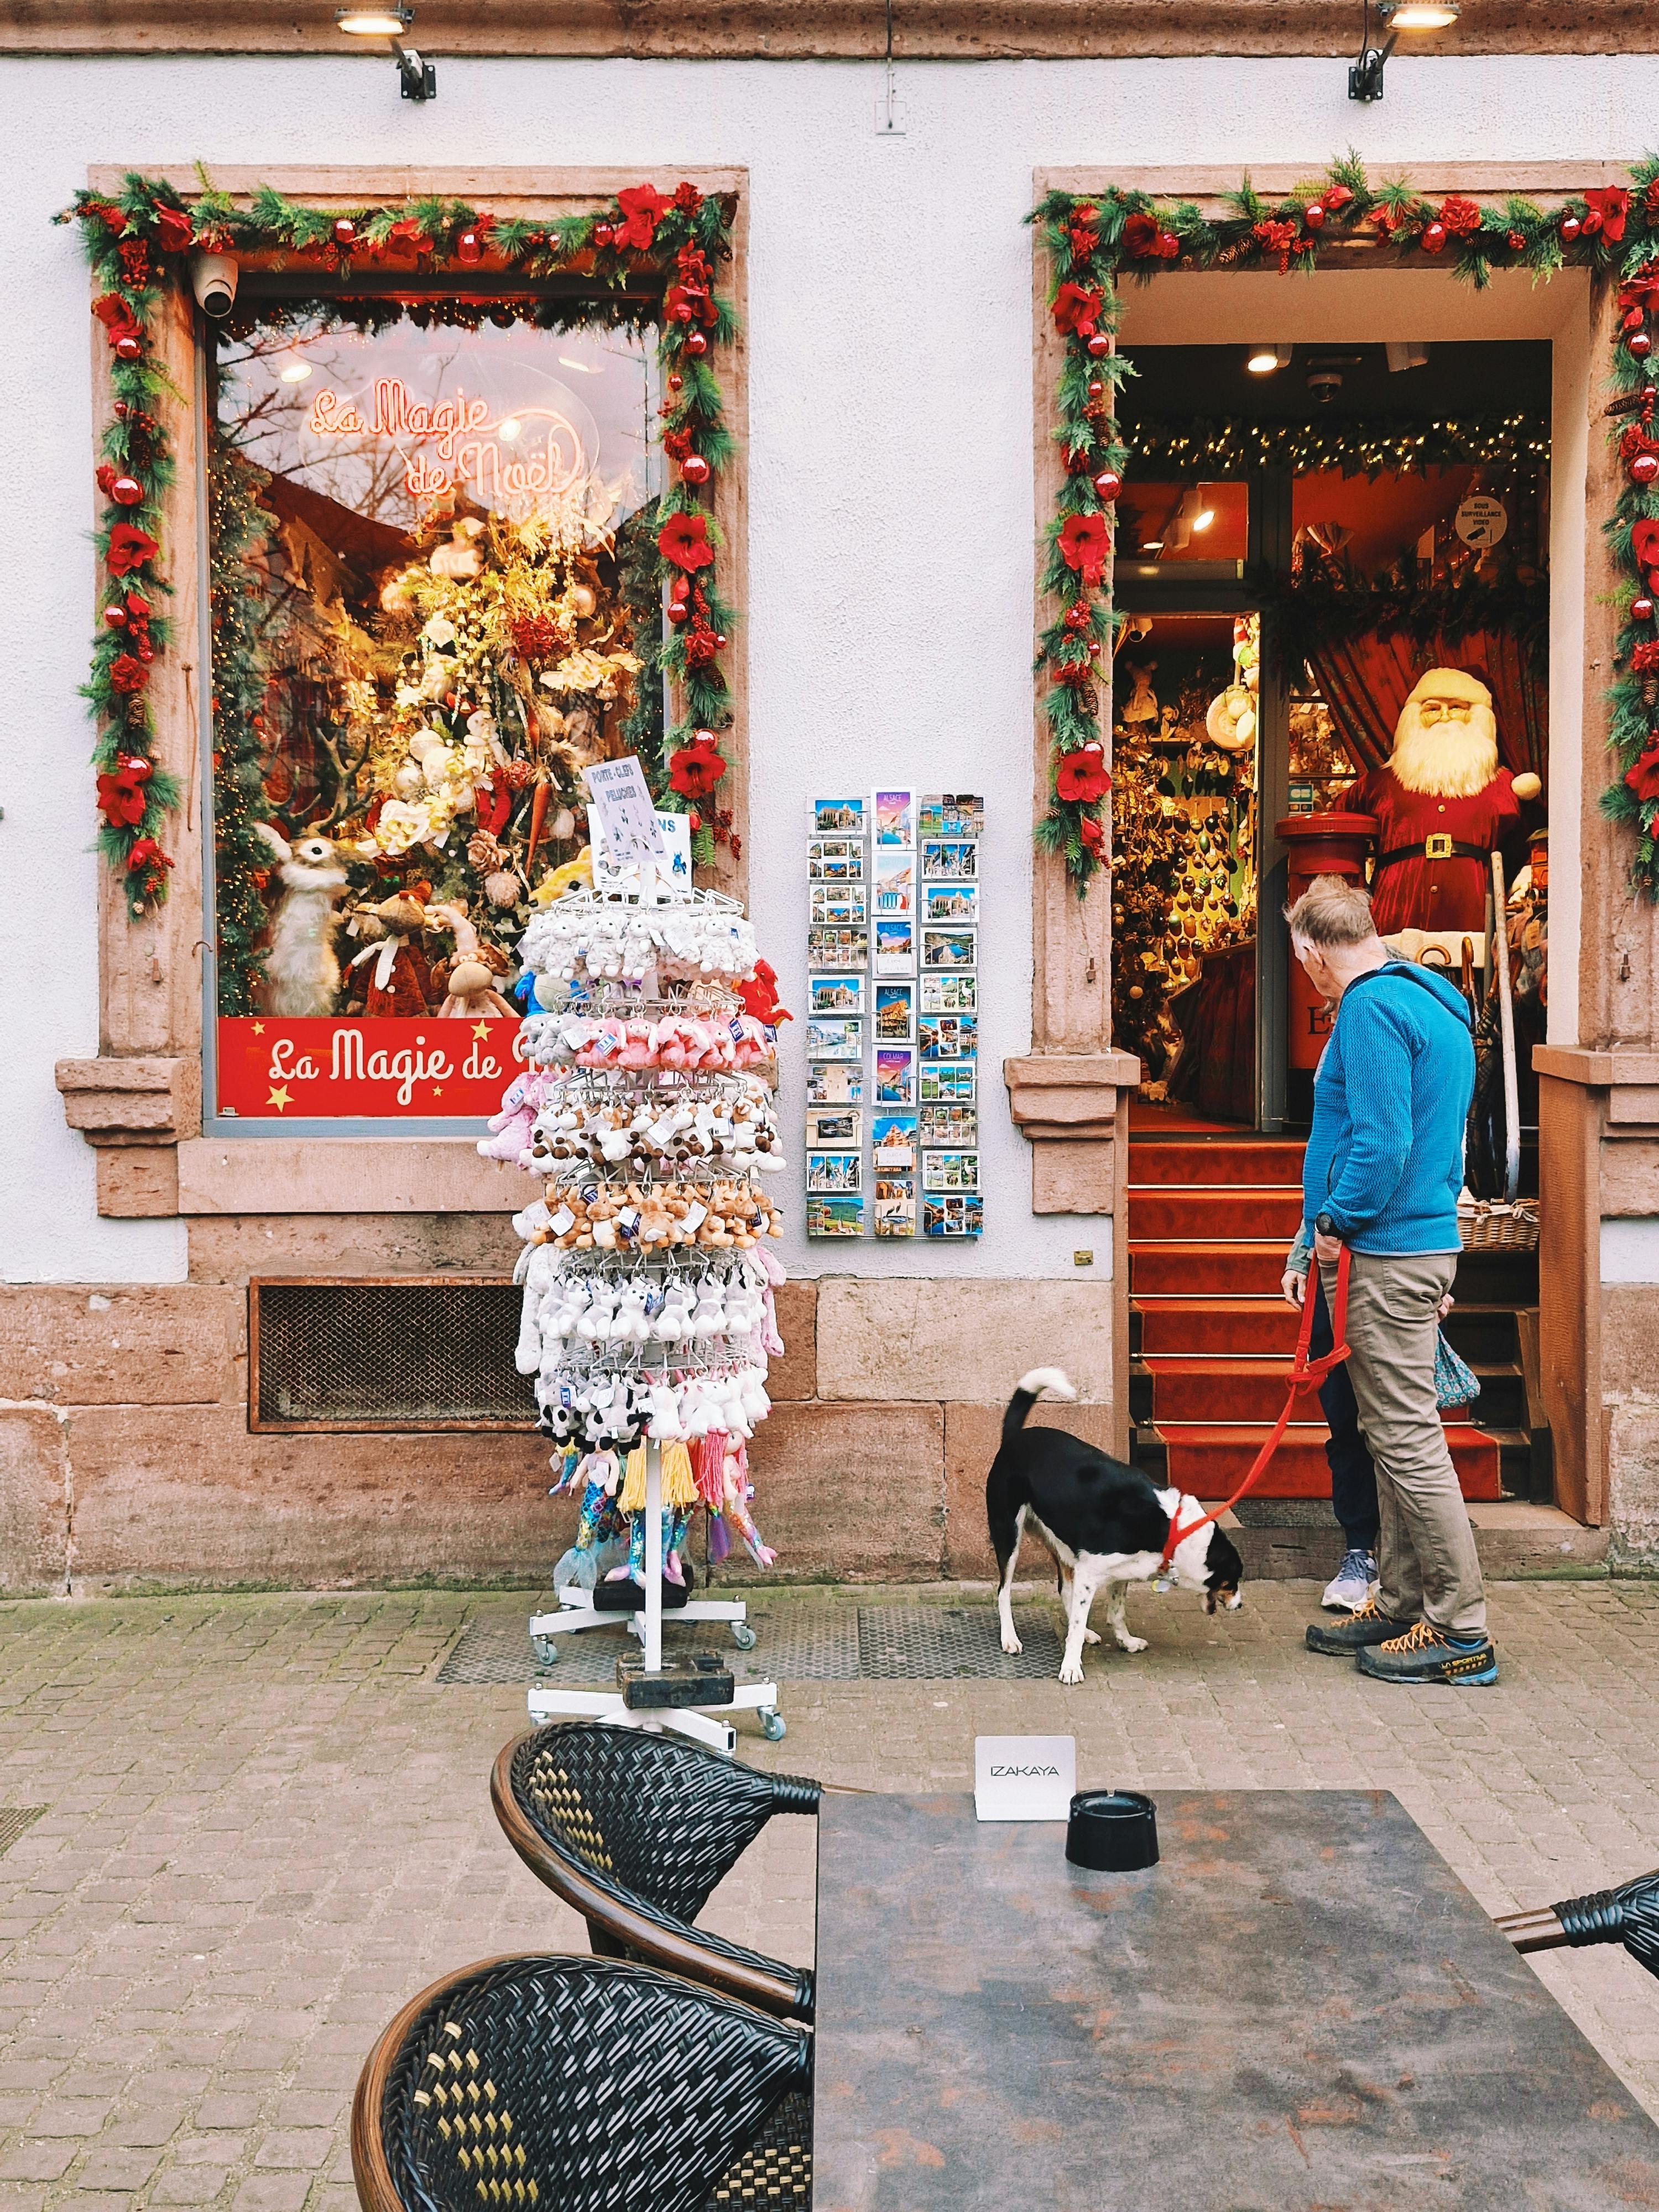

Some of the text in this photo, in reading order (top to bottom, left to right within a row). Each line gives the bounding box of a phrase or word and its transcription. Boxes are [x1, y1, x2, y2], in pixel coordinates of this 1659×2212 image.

[310, 378, 489, 460] La Magie
[406, 422, 580, 497] de Noël
[268, 1039, 320, 1080] La
[329, 1029, 454, 1105] Magie
[462, 1041, 502, 1080] de
[990, 1766, 1060, 1776] IZAKAYA
